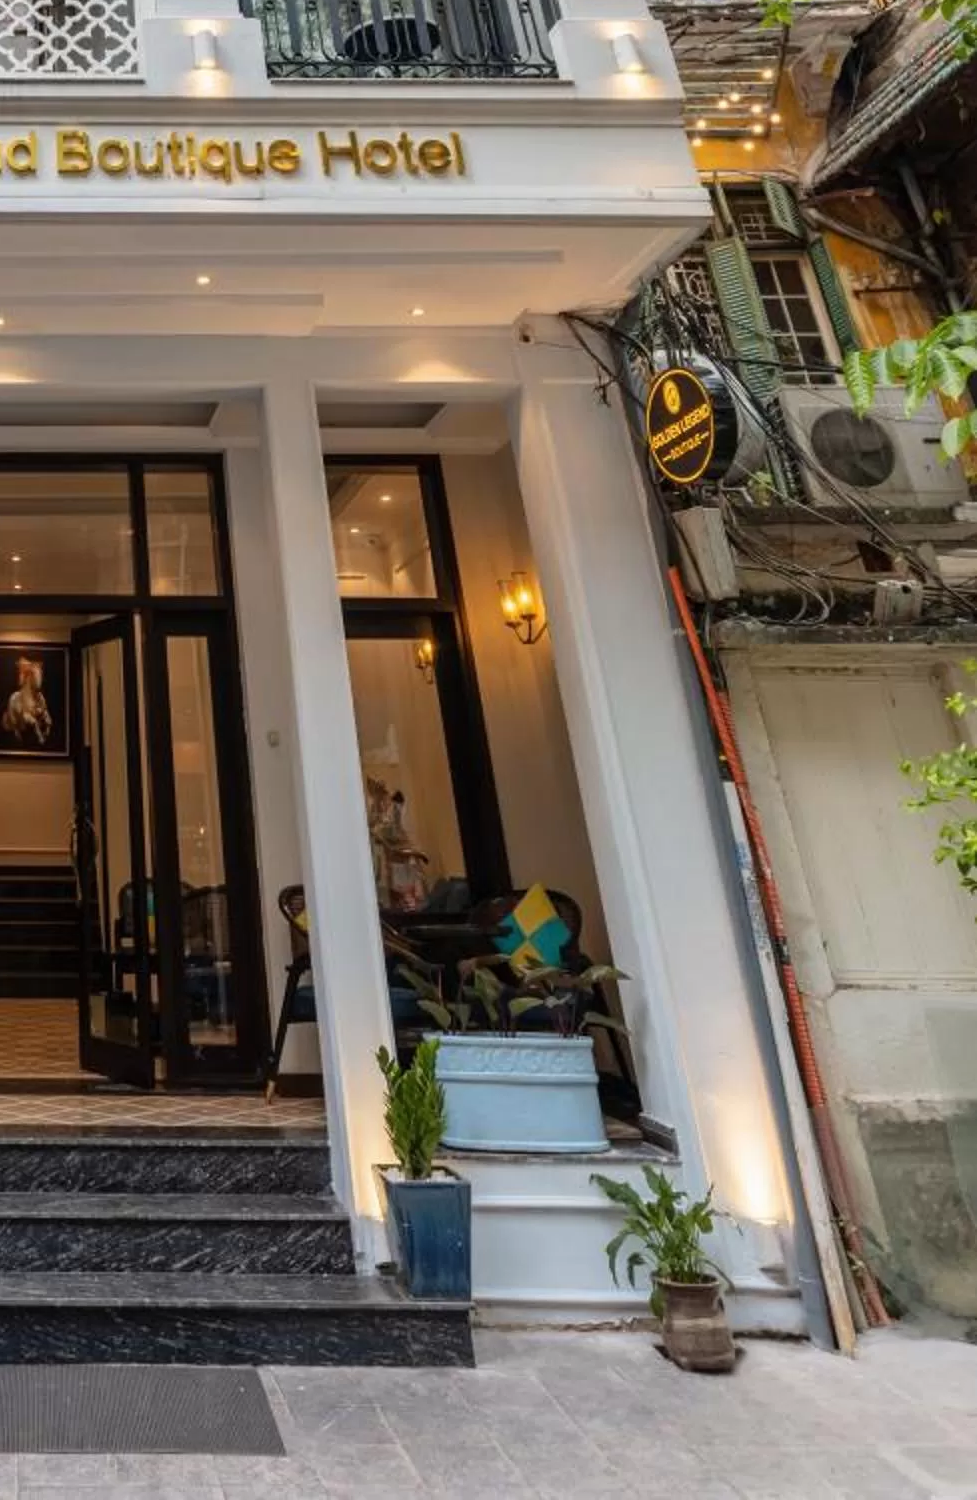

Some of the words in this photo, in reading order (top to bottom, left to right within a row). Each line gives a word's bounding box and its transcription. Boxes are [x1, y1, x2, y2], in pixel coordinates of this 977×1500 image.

[56, 130, 302, 183] Boutique
[317, 130, 466, 176] Hotel
[652, 422, 682, 449] GOLDEN
[680, 404, 710, 433] LEGEND
